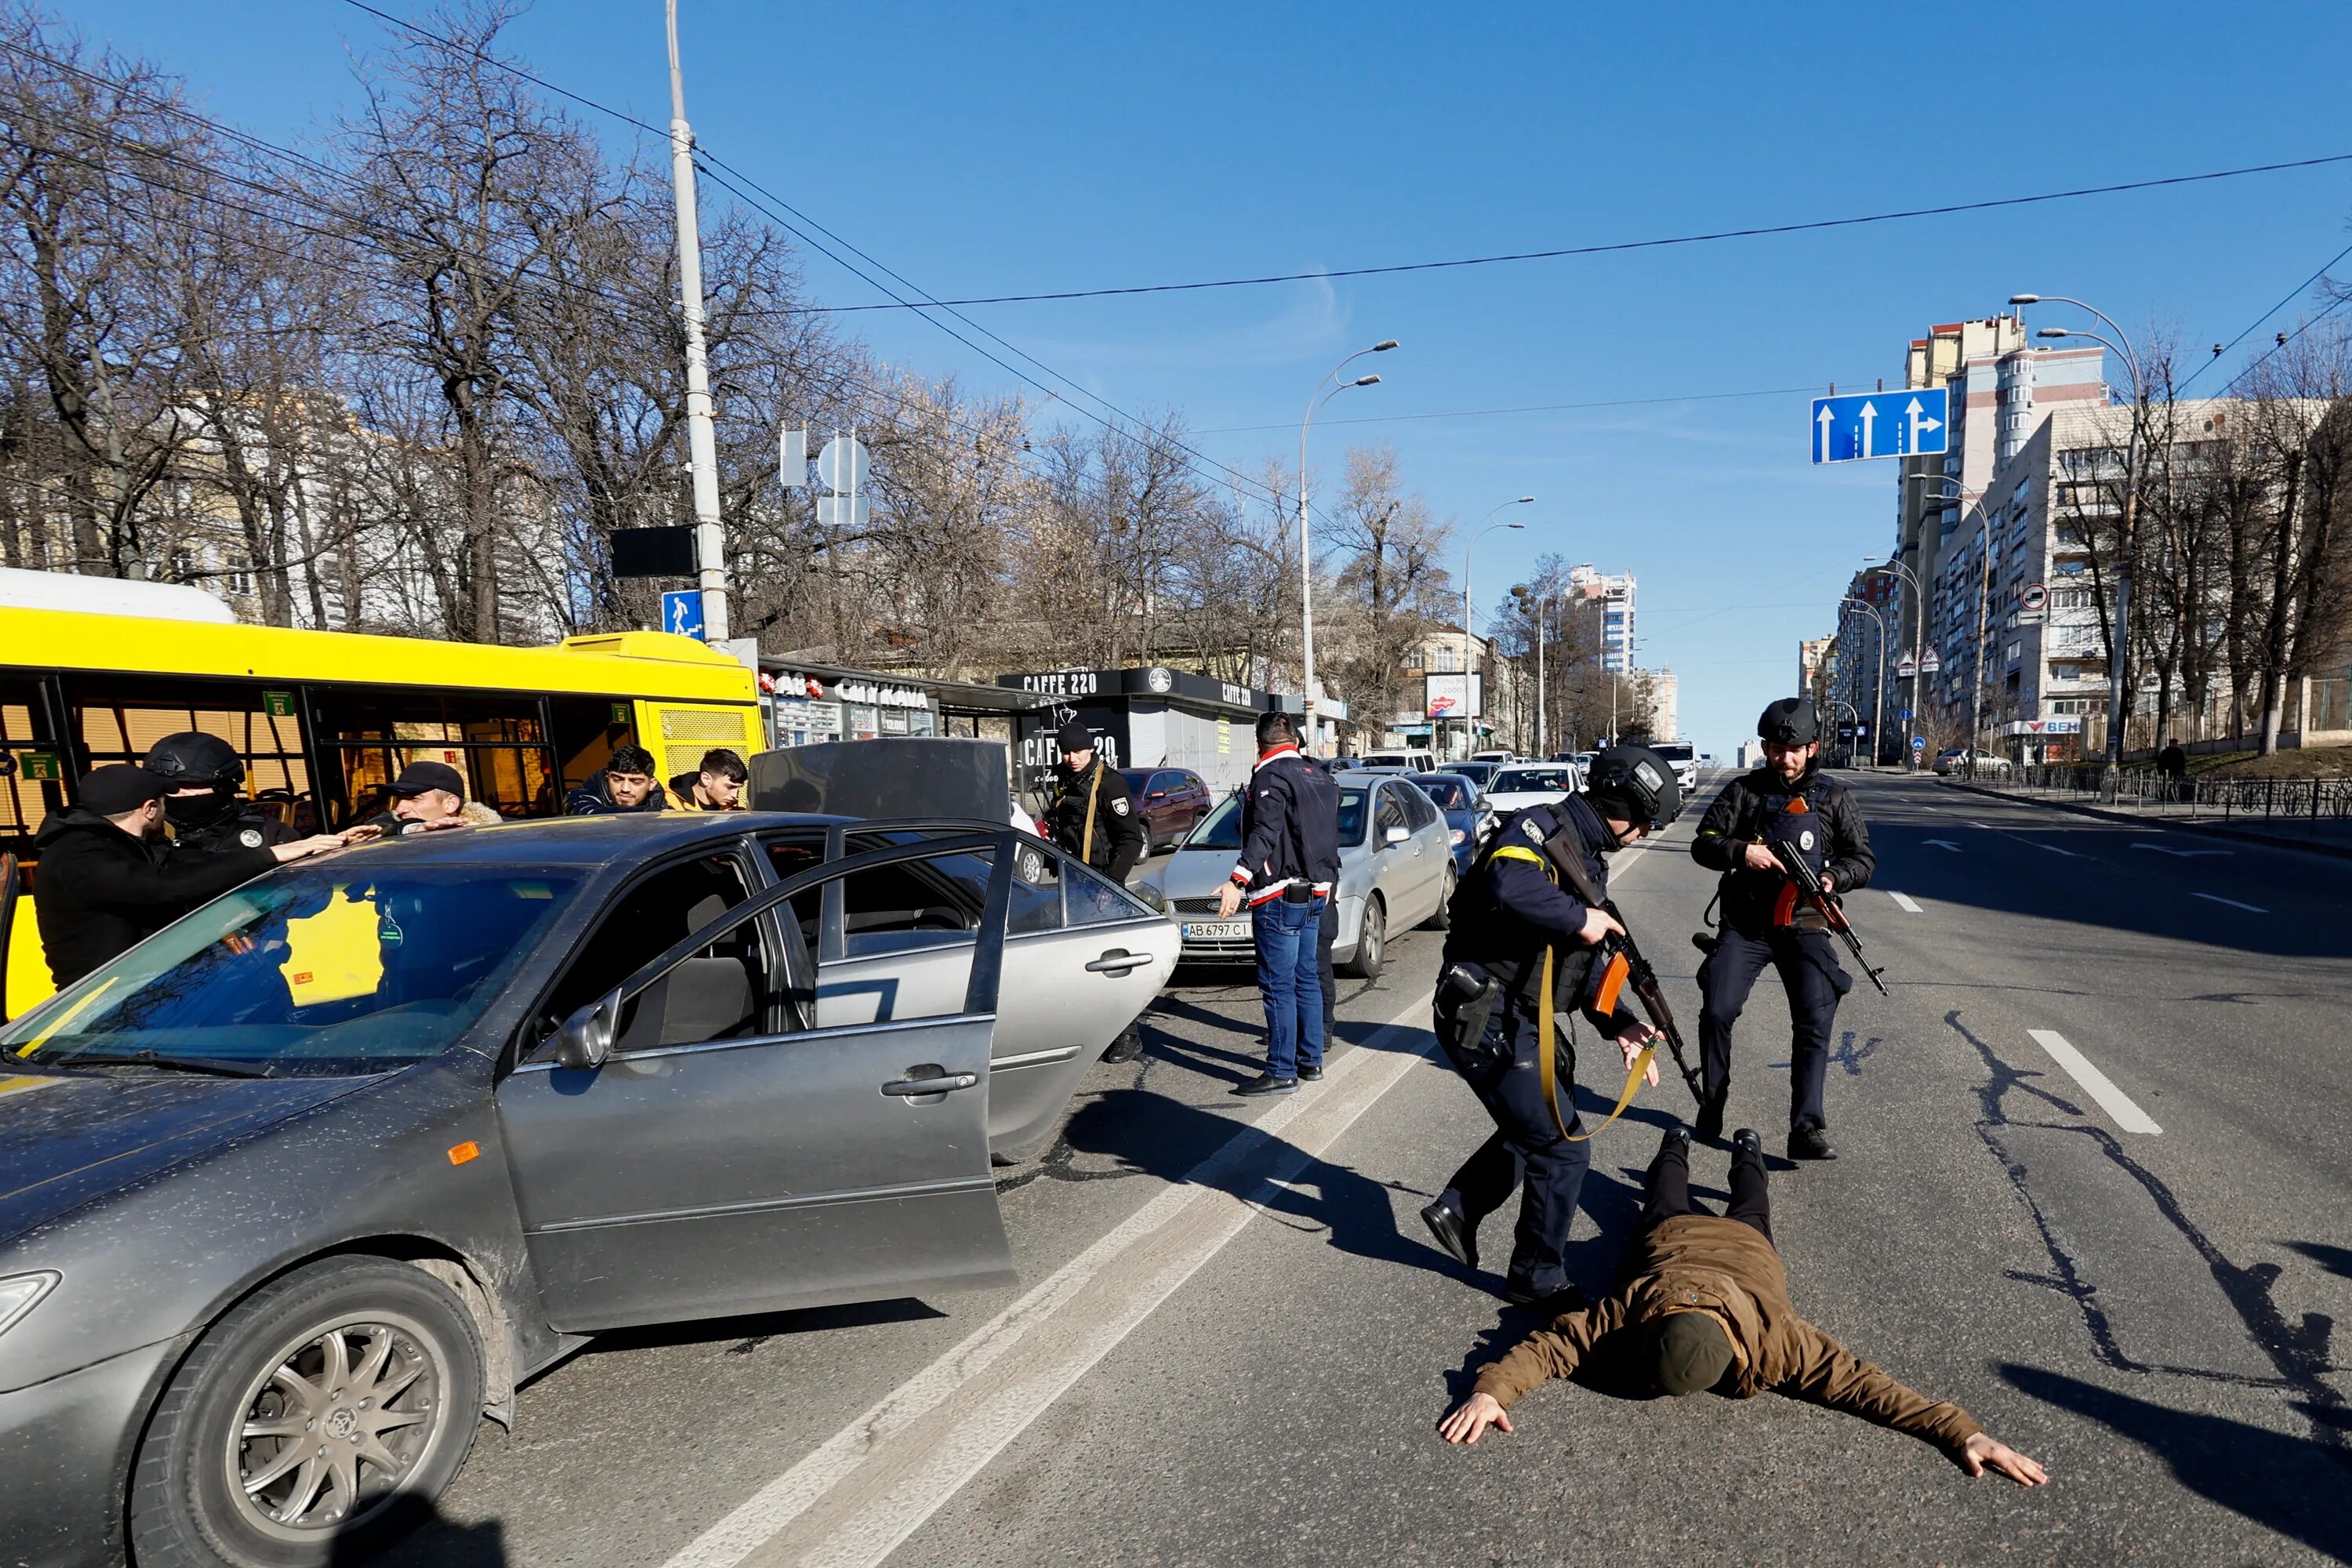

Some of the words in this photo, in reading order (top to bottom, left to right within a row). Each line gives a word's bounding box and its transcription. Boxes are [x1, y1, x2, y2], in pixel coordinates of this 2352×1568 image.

[880, 683, 928, 709] KAVA
[1024, 674, 1066, 695] CAFFE
[1071, 673, 1097, 694] 220
[1222, 683, 1240, 705] CAFFE
[1241, 687, 1251, 707] 220
[1025, 738, 1062, 766] CAF
[1189, 925, 1203, 936] AB
[1207, 925, 1229, 936] 6797
